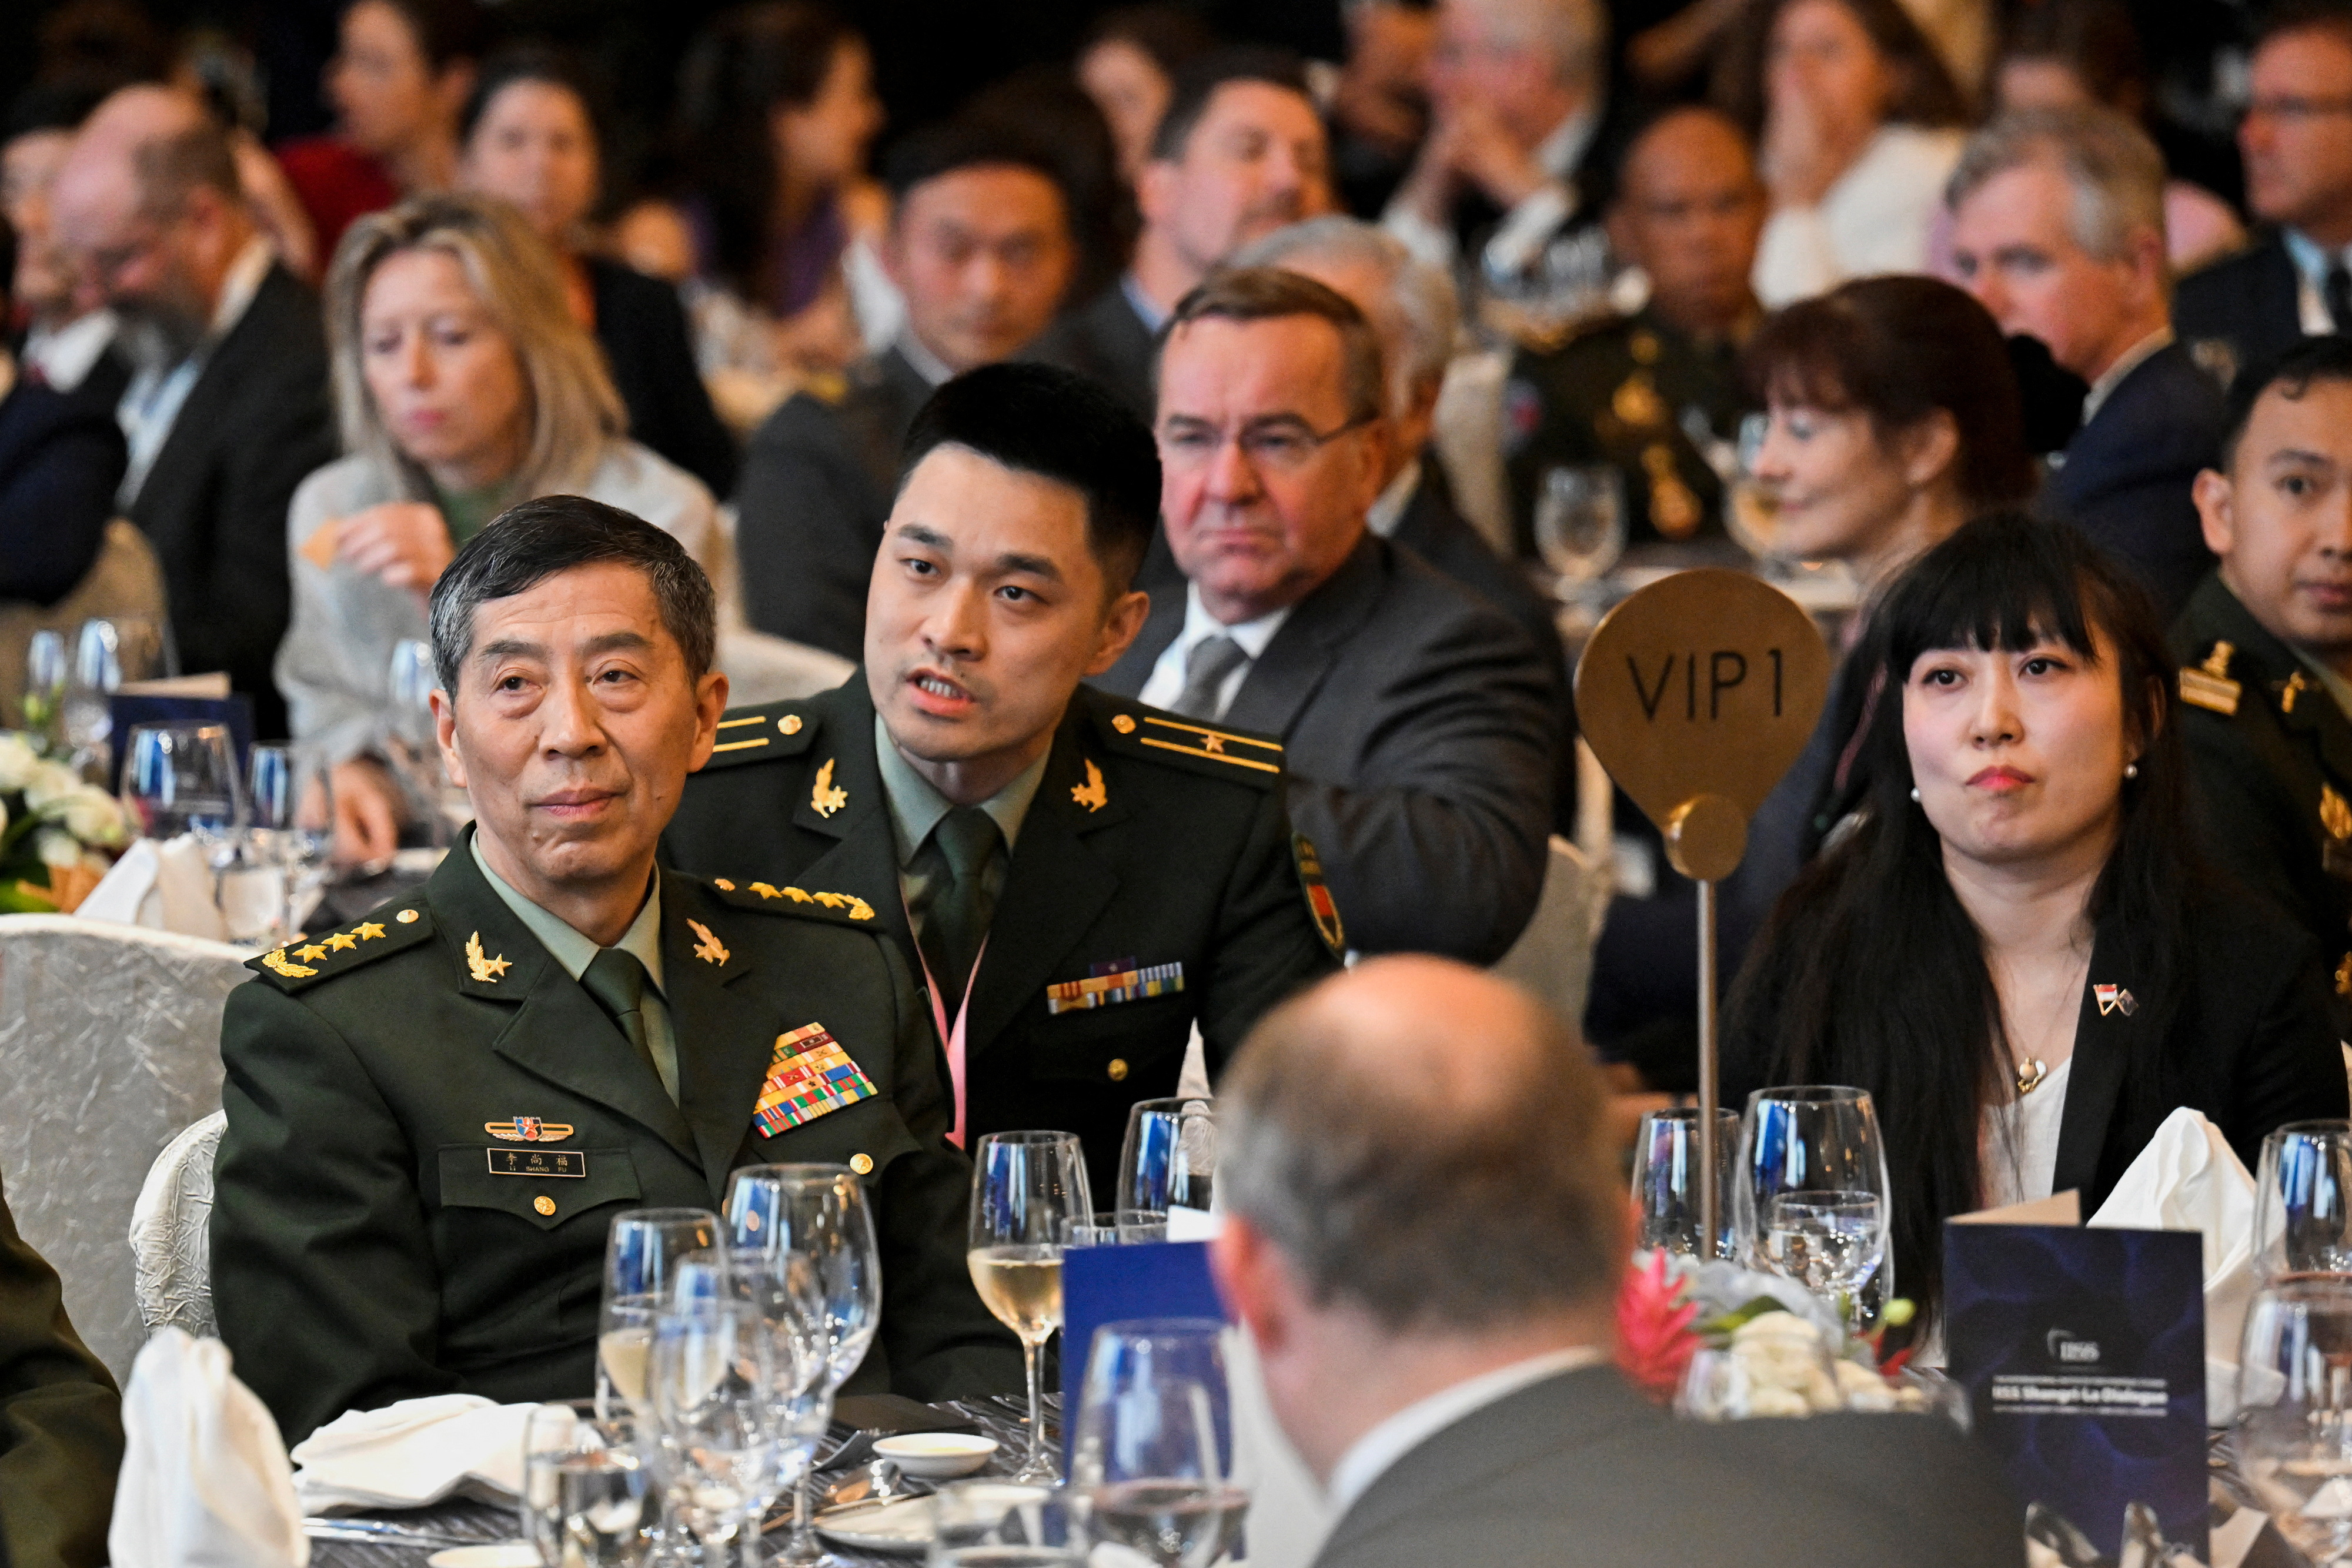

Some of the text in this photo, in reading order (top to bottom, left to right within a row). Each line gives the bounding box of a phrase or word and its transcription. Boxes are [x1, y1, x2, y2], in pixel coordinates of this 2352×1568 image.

[1626, 648, 1782, 723] VIP 1
[506, 1152, 567, 1166] 李尚福
